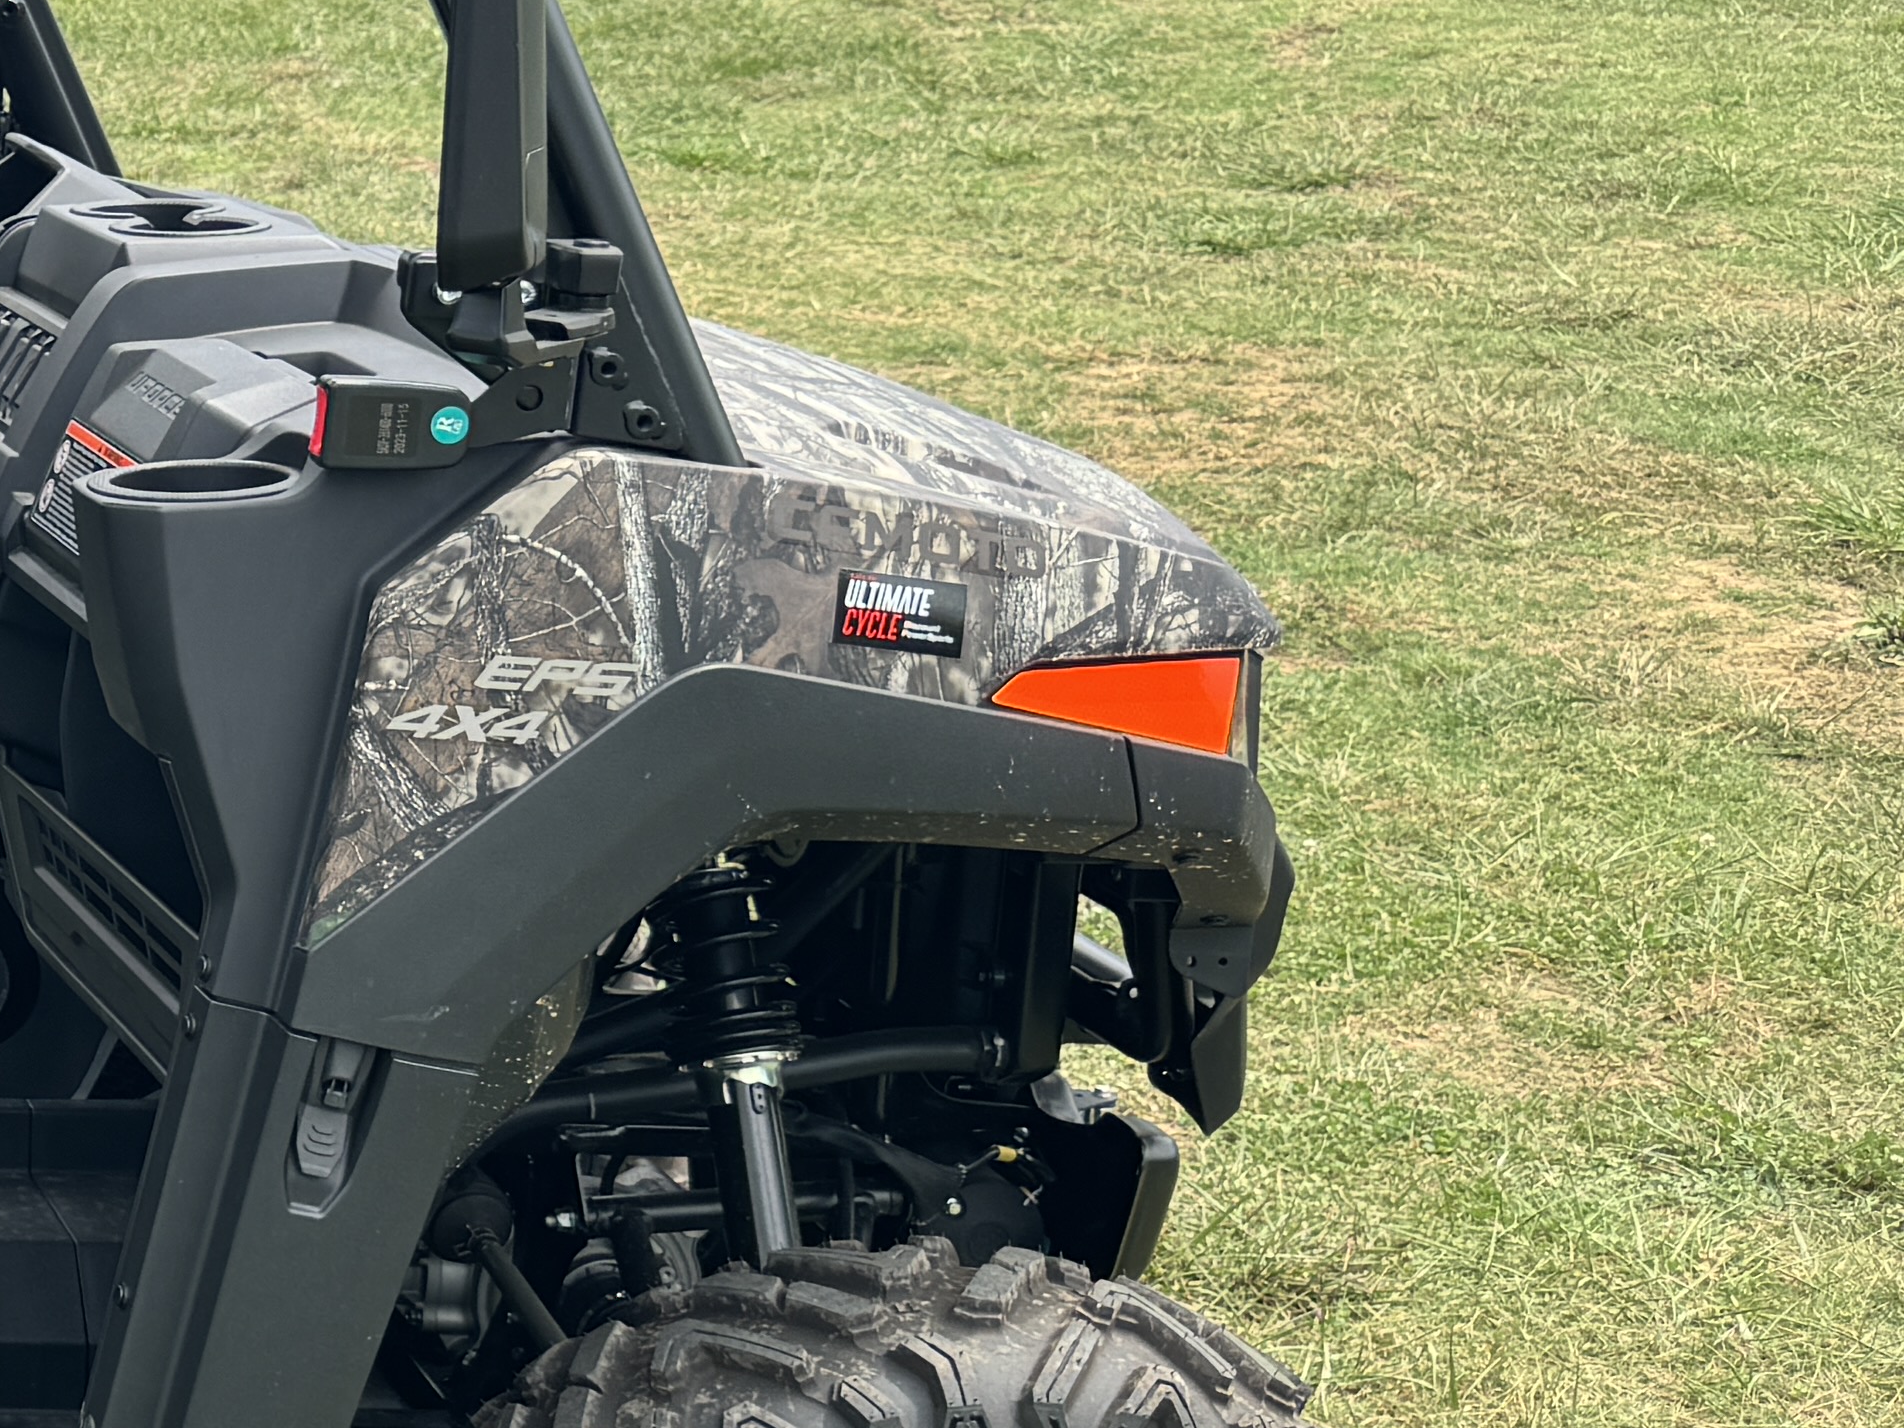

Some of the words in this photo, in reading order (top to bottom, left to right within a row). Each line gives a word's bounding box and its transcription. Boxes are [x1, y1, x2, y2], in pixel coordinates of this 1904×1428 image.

[765, 495, 1046, 578] CFMOTO
[844, 578, 935, 617] ULTIMATE
[842, 608, 903, 641] CYCLE
[473, 654, 642, 697] EPS
[385, 704, 549, 744] 4X4
